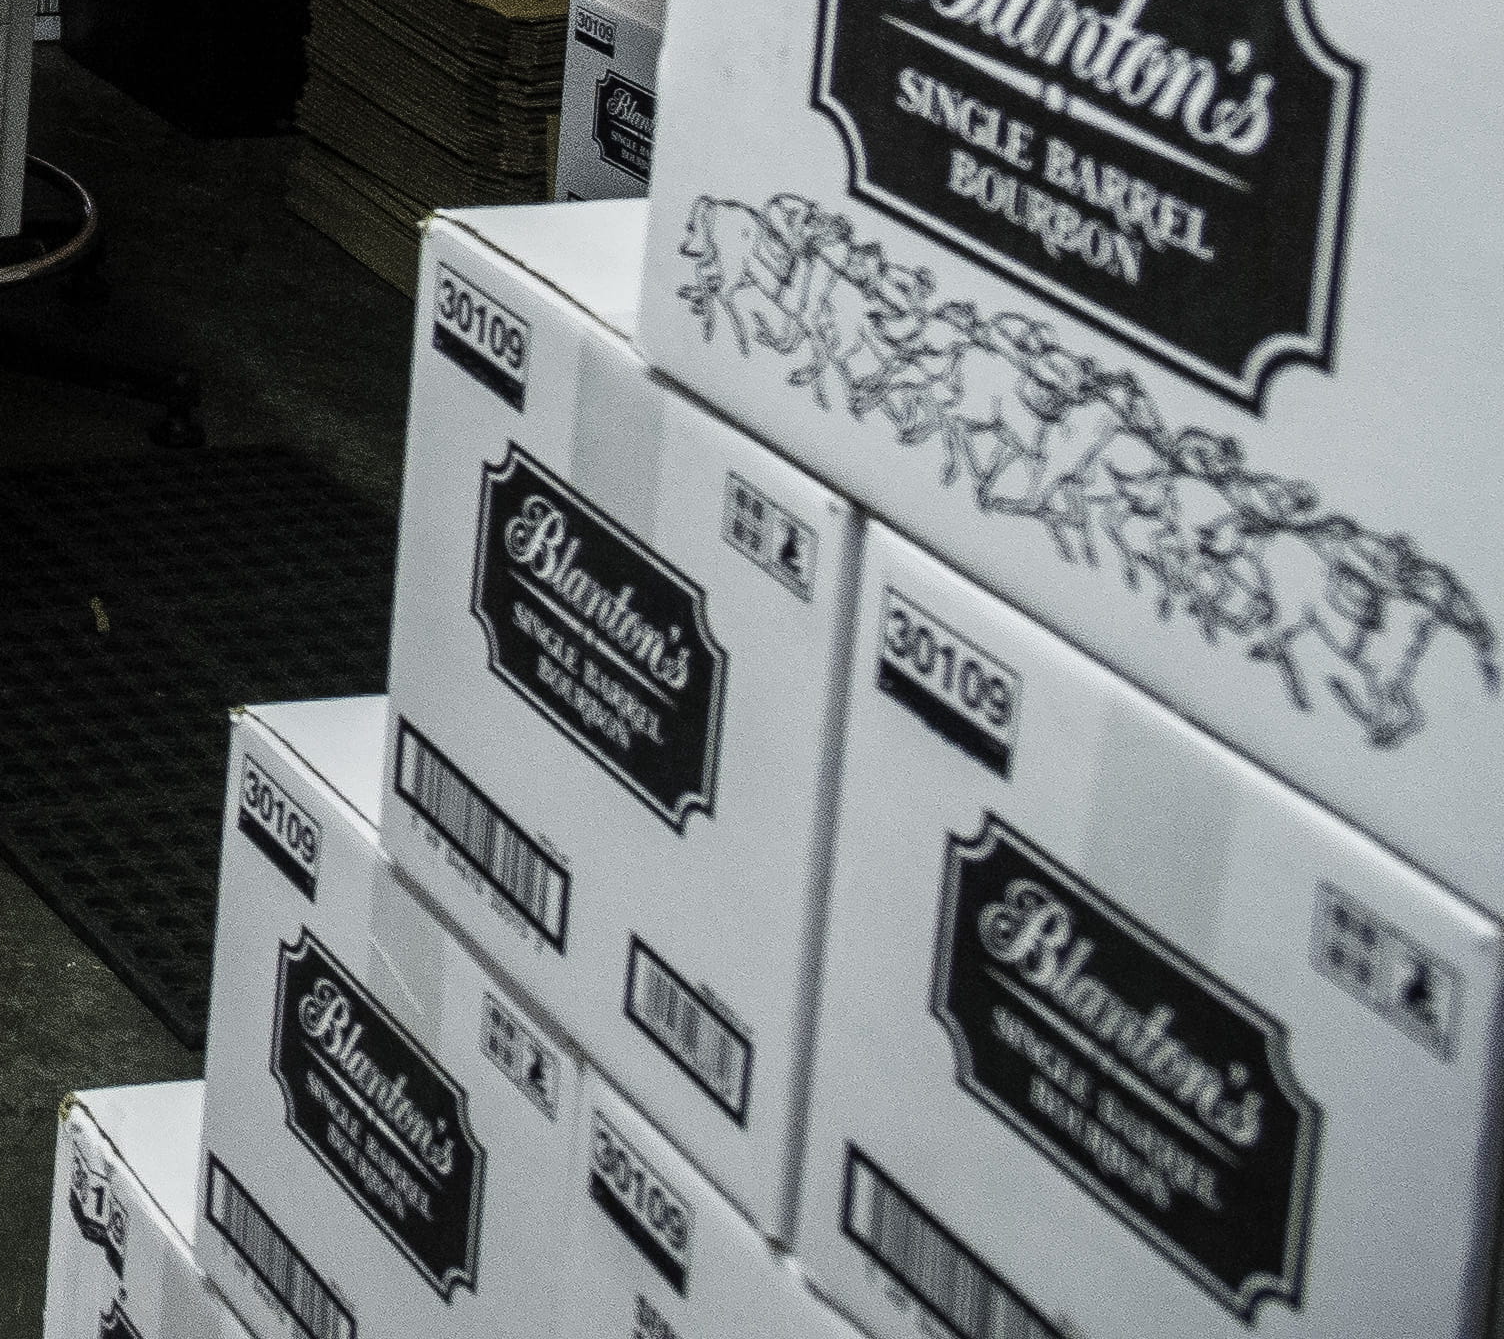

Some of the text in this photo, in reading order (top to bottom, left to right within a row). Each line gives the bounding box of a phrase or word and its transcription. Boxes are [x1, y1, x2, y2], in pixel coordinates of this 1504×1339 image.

[576, 9, 616, 42] 30109
[896, 67, 1216, 261] SINGLE BARREL
[947, 147, 1145, 287] BOURBON
[438, 277, 526, 370] 30109
[503, 494, 691, 692] Blanton's
[883, 607, 1014, 728] 30109
[243, 771, 318, 867] 30109
[297, 974, 456, 1177] Blanton's
[977, 877, 1267, 1148] Blanton's
